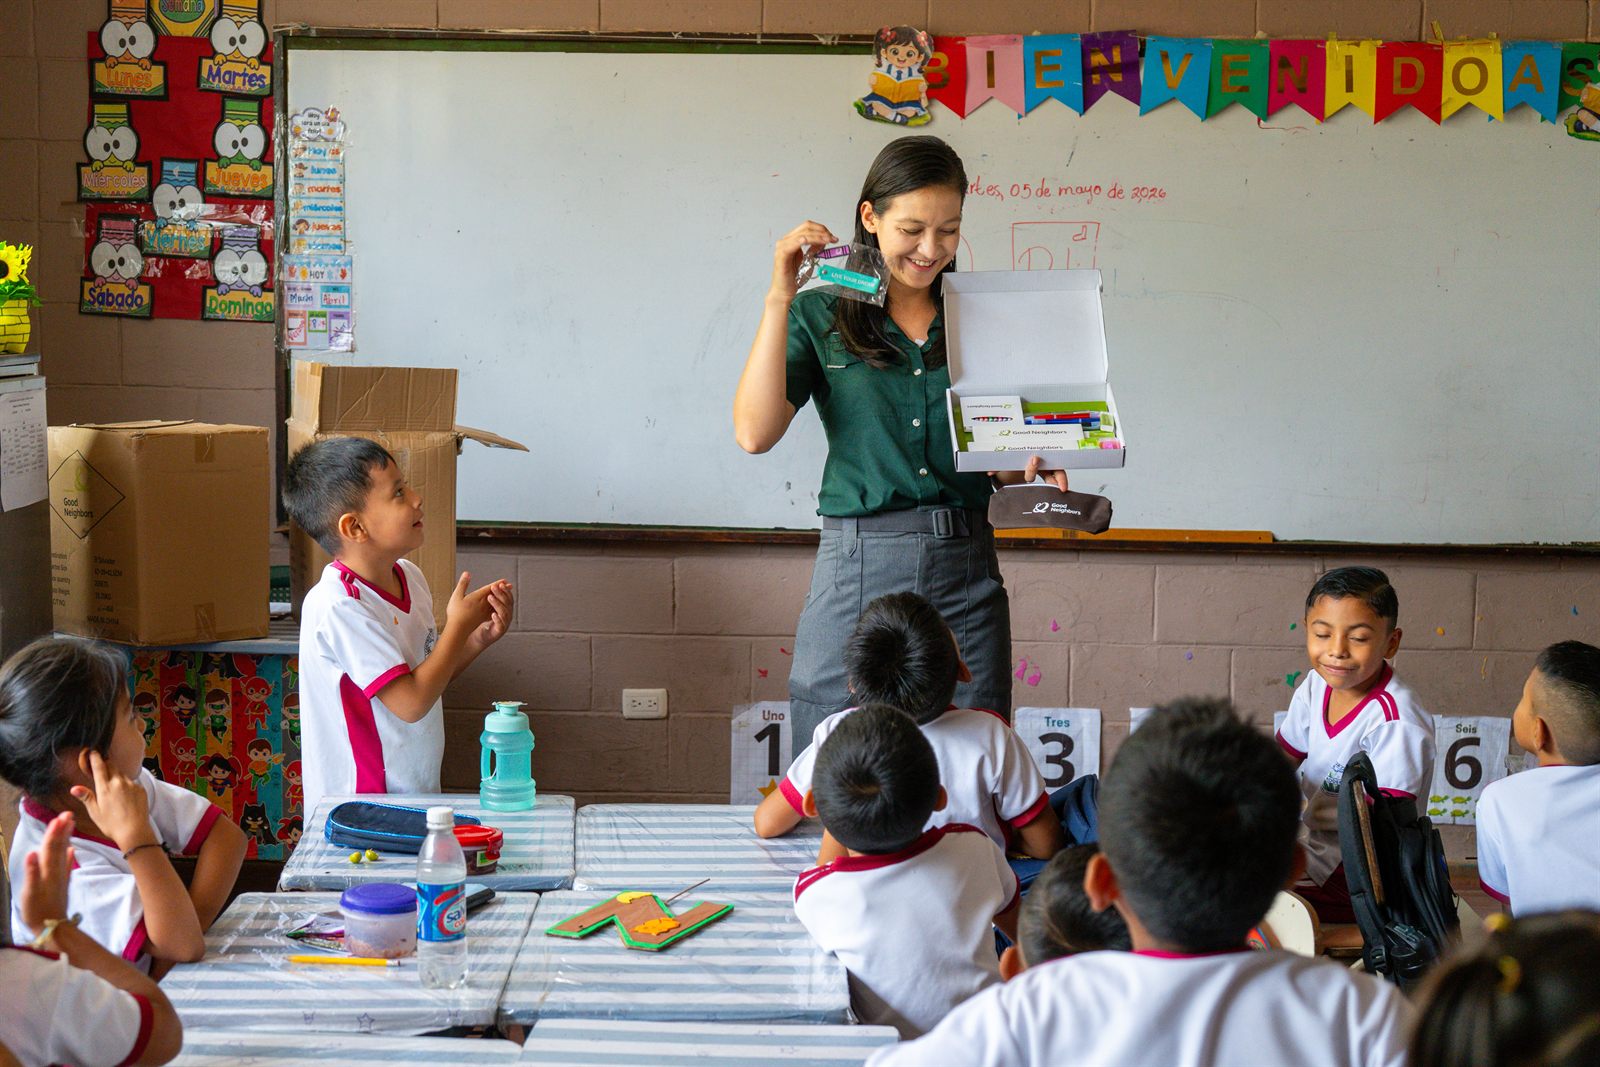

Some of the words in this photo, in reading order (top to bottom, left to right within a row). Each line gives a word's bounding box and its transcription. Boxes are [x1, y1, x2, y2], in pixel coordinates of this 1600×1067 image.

[105, 66, 153, 88] Lunes
[206, 64, 267, 89] Martes
[82, 171, 147, 189] Miércoles
[209, 168, 269, 189] Jueves
[307, 185, 342, 194] martes
[1010, 183, 1032, 198] 05
[1035, 177, 1051, 198] de
[1058, 184, 1102, 205] mayo
[1107, 182, 1125, 199] de
[1130, 186, 1167, 201] 2026
[145, 228, 206, 250] Viernes
[309, 270, 325, 279] HOY
[88, 287, 145, 307] Sábado
[208, 296, 274, 318] Domingo
[64, 497, 79, 507] Good
[1050, 506, 1082, 516] Neighbors
[64, 508, 94, 519] Neighbors
[762, 709, 785, 722] Uno
[1044, 715, 1071, 728] Tres
[1455, 723, 1478, 735] Seis
[753, 723, 781, 776] 1
[1037, 732, 1075, 788] 3
[1444, 737, 1482, 790] 6
